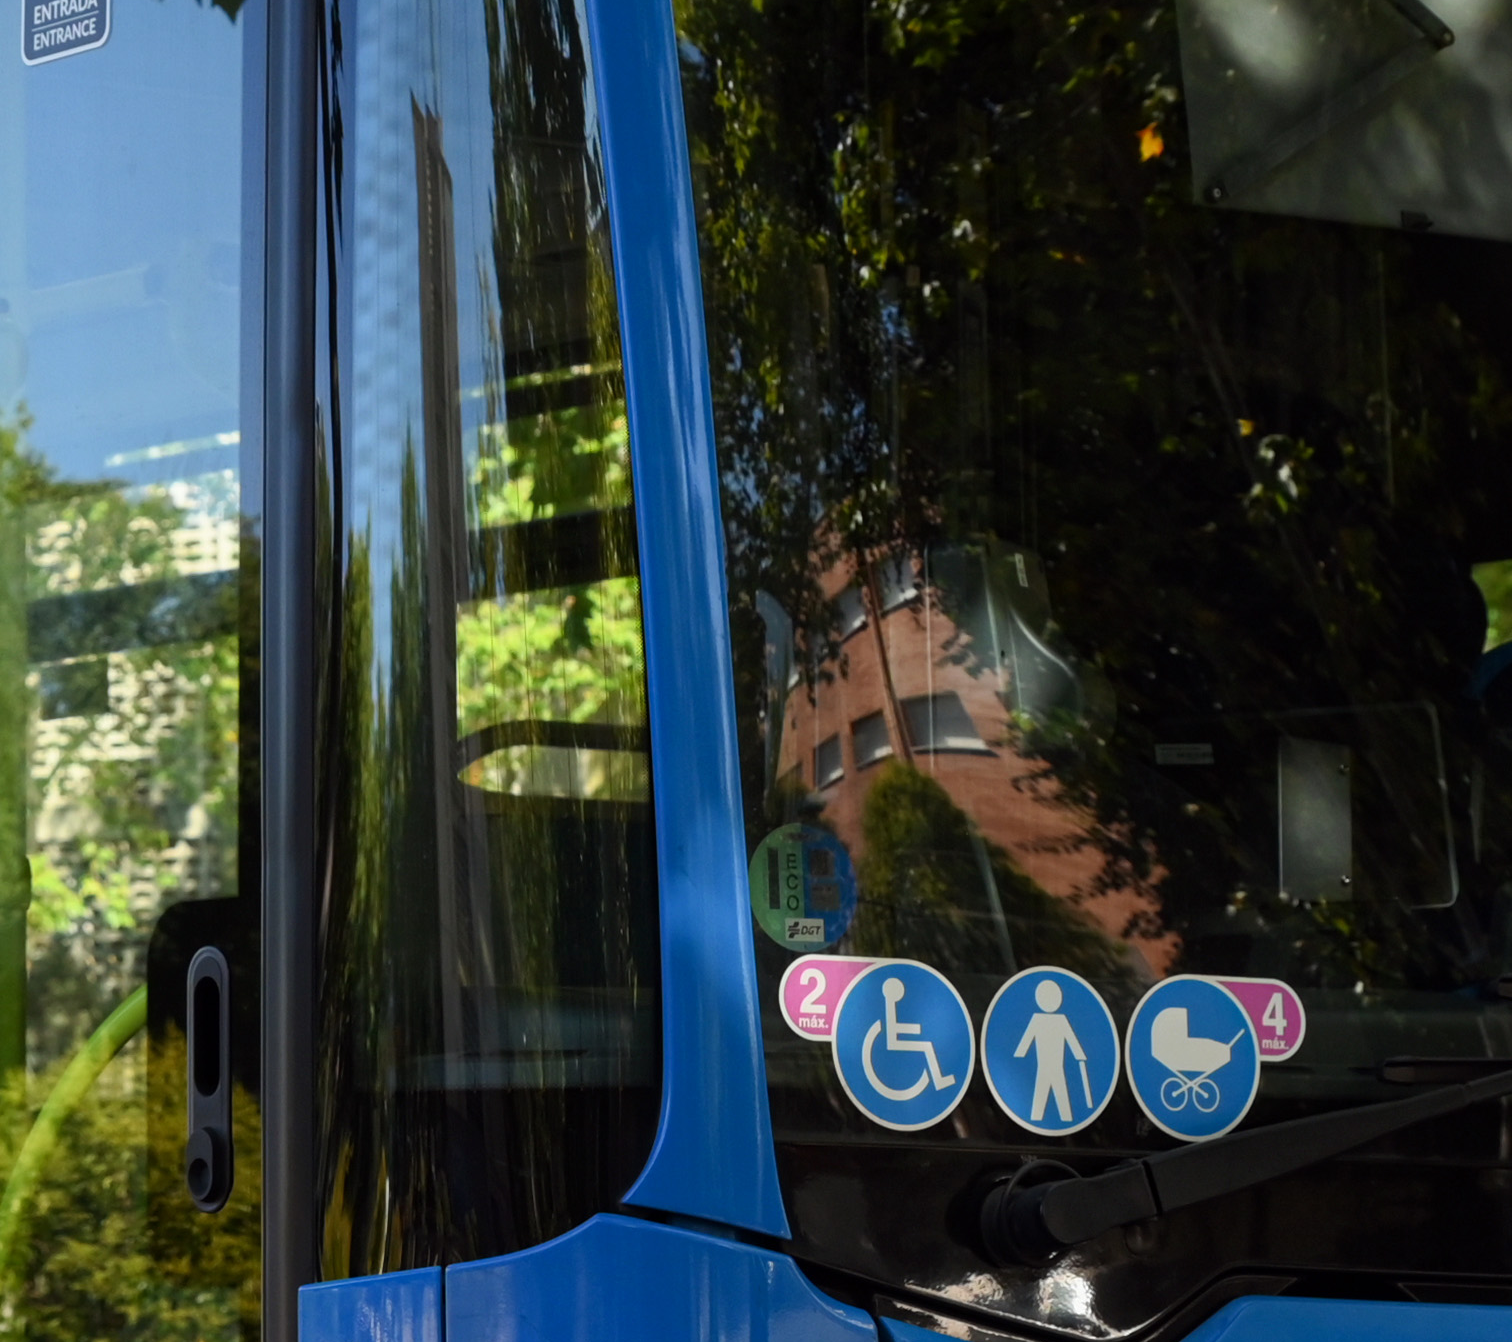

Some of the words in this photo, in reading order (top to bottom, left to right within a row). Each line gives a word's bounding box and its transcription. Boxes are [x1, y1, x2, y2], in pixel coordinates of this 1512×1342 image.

[33, 17, 97, 51] ENTRANCE
[786, 853, 800, 911] ECO
[800, 926, 822, 935] DGT
[799, 967, 827, 1014] 2
[799, 1015, 829, 1029] máx.
[1261, 992, 1288, 1036] 4
[1262, 1036, 1289, 1050] máx.
